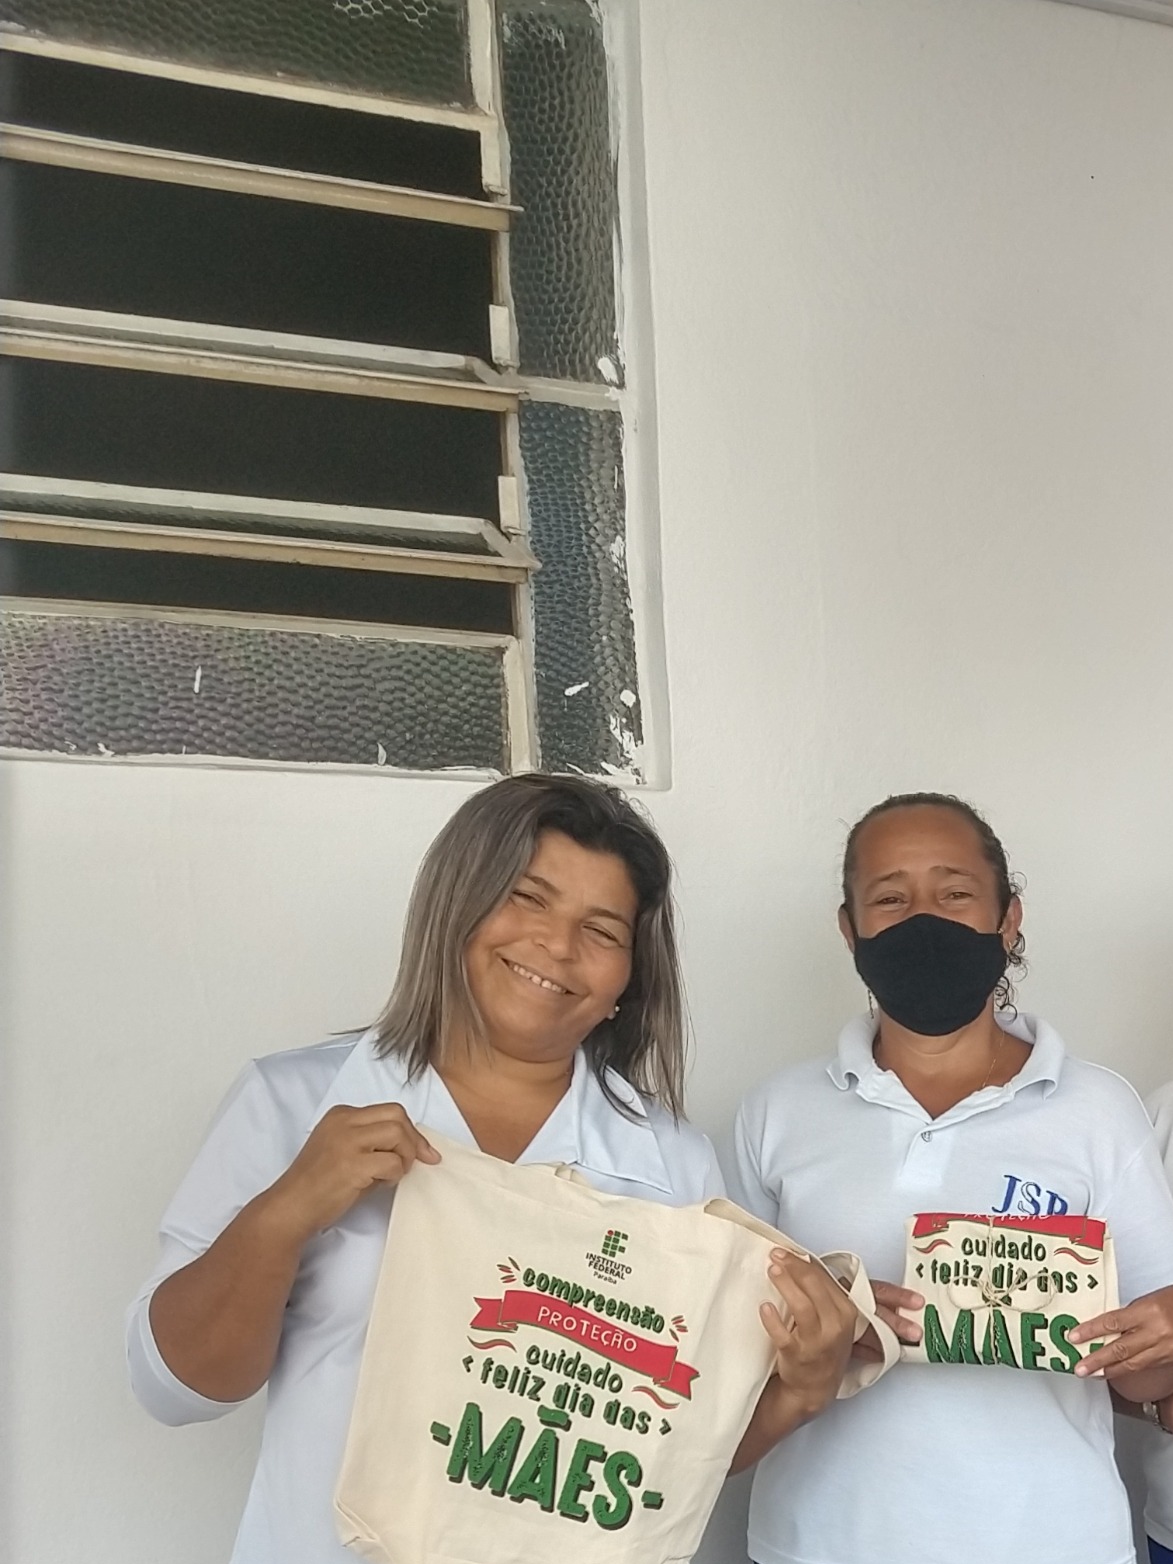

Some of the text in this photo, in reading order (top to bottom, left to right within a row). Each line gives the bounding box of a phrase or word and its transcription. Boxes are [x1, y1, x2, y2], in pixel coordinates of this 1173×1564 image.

[585, 1252, 632, 1274] INSTITUTO
[588, 1260, 625, 1280] FEDERAL
[931, 1259, 983, 1288] feliz
[522, 1268, 664, 1334] compreensão
[537, 1306, 637, 1352] PROTEÇÃO
[526, 1344, 623, 1393] cuidado
[481, 1357, 652, 1435] feliz dia das
